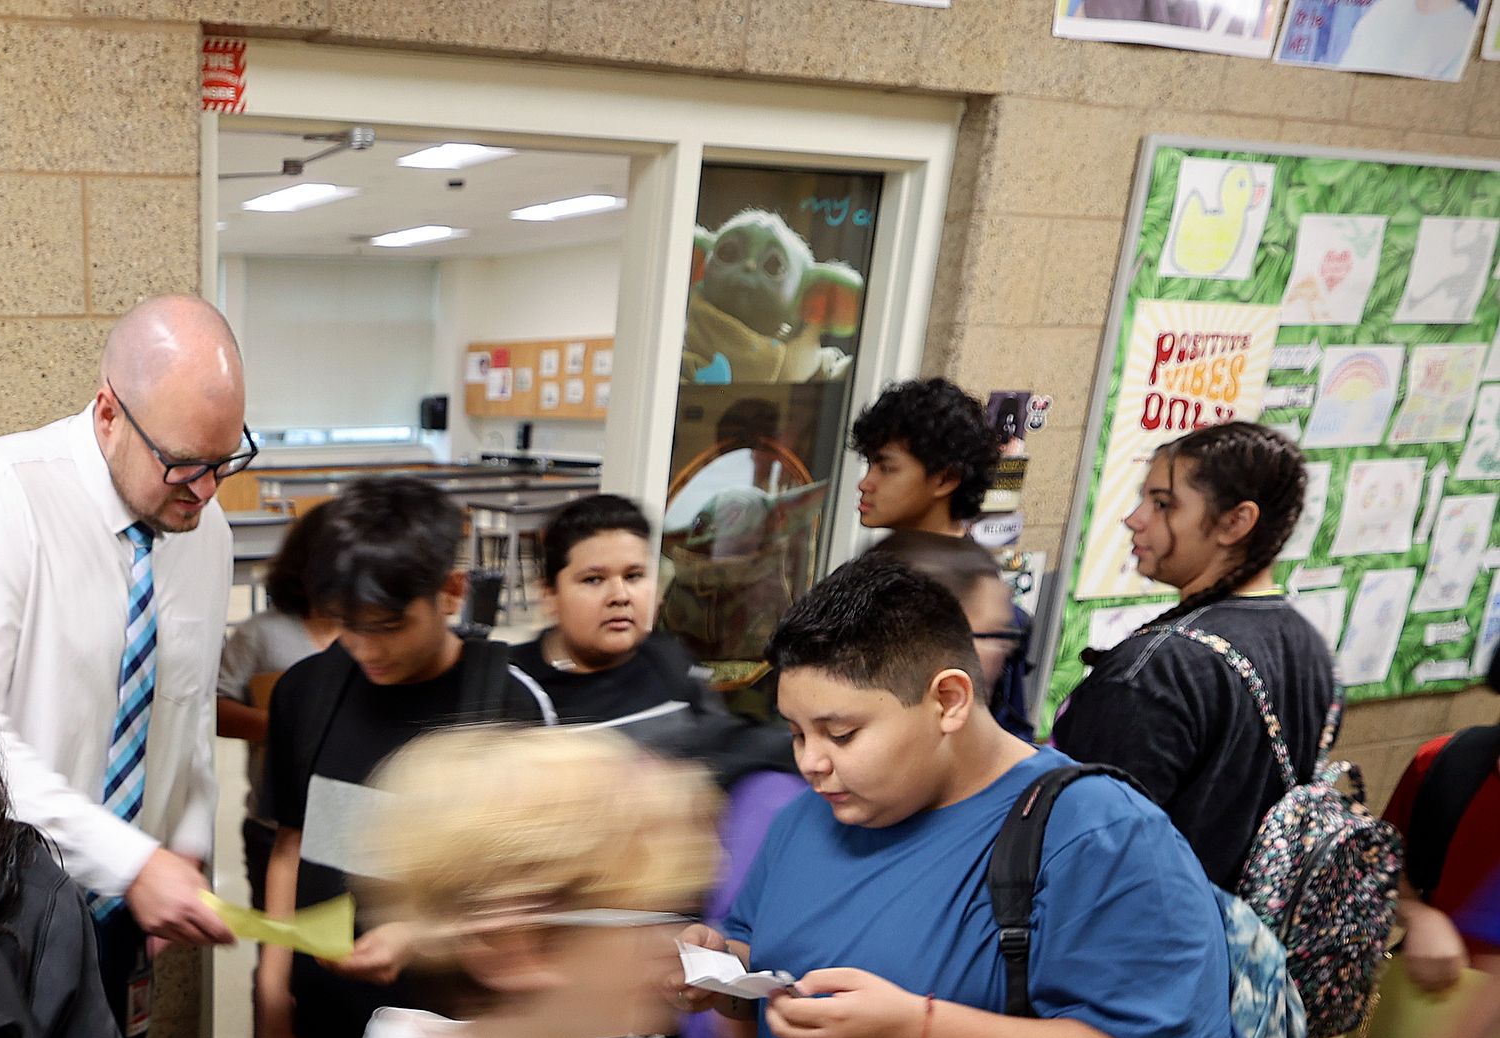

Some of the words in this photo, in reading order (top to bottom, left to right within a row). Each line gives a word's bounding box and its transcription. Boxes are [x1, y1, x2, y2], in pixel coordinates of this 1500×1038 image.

[202, 86, 236, 100] NSIDE
[1149, 332, 1252, 386] POSITIVE
[1165, 354, 1245, 403] VIBES
